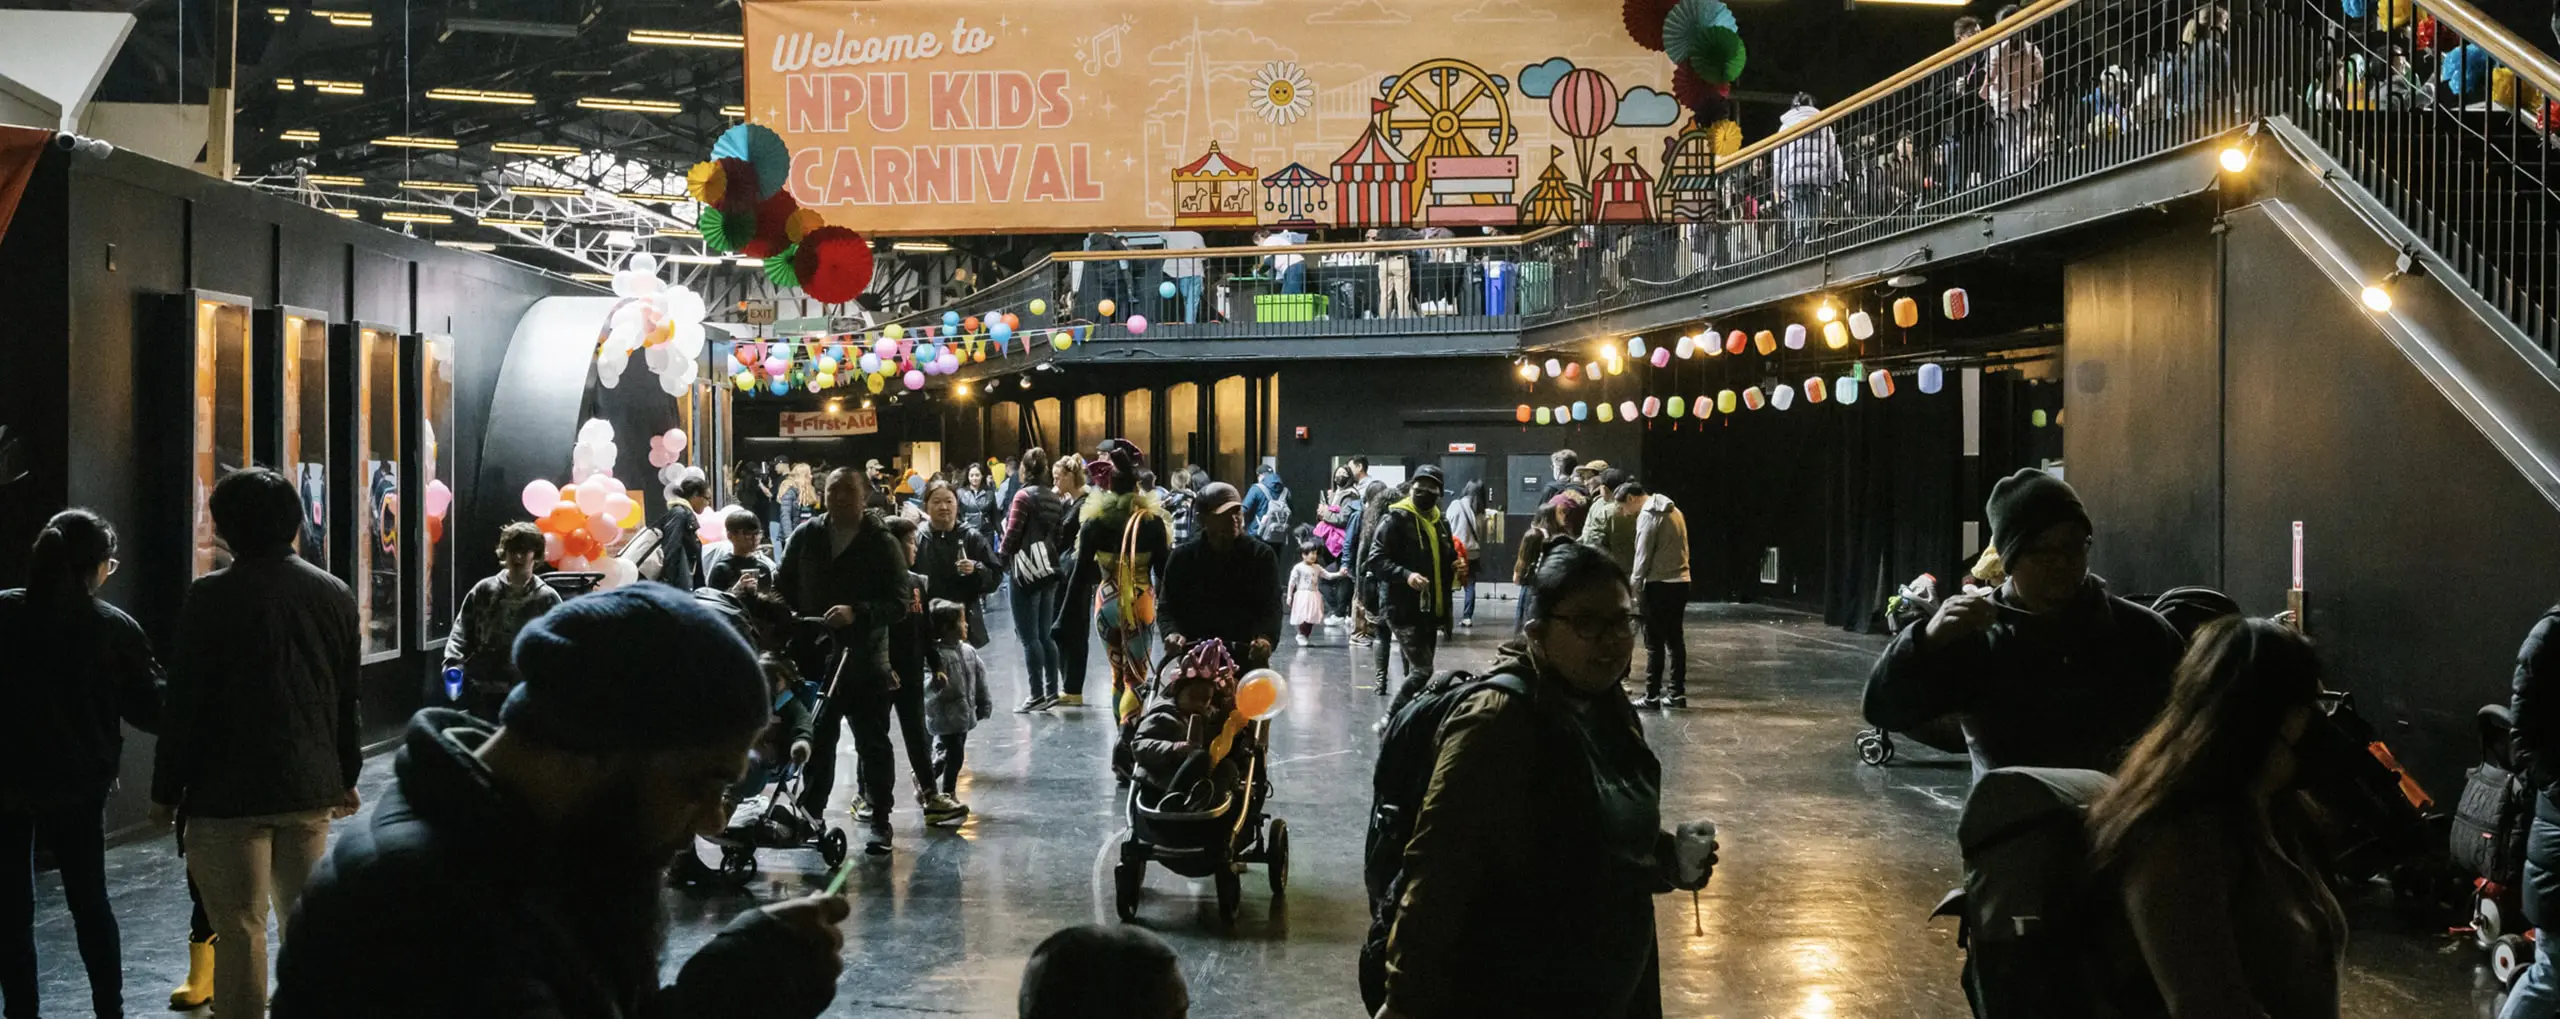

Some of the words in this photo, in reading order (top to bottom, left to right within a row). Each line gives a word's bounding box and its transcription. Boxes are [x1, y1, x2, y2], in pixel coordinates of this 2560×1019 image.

[772, 29, 943, 73] Welcome
[951, 17, 995, 54] to
[786, 72, 909, 133] NPU
[929, 69, 1073, 131] KIDS
[788, 143, 1105, 206] CARNIVAL
[750, 308, 773, 319] EXIT
[802, 411, 876, 432] First-Aid
